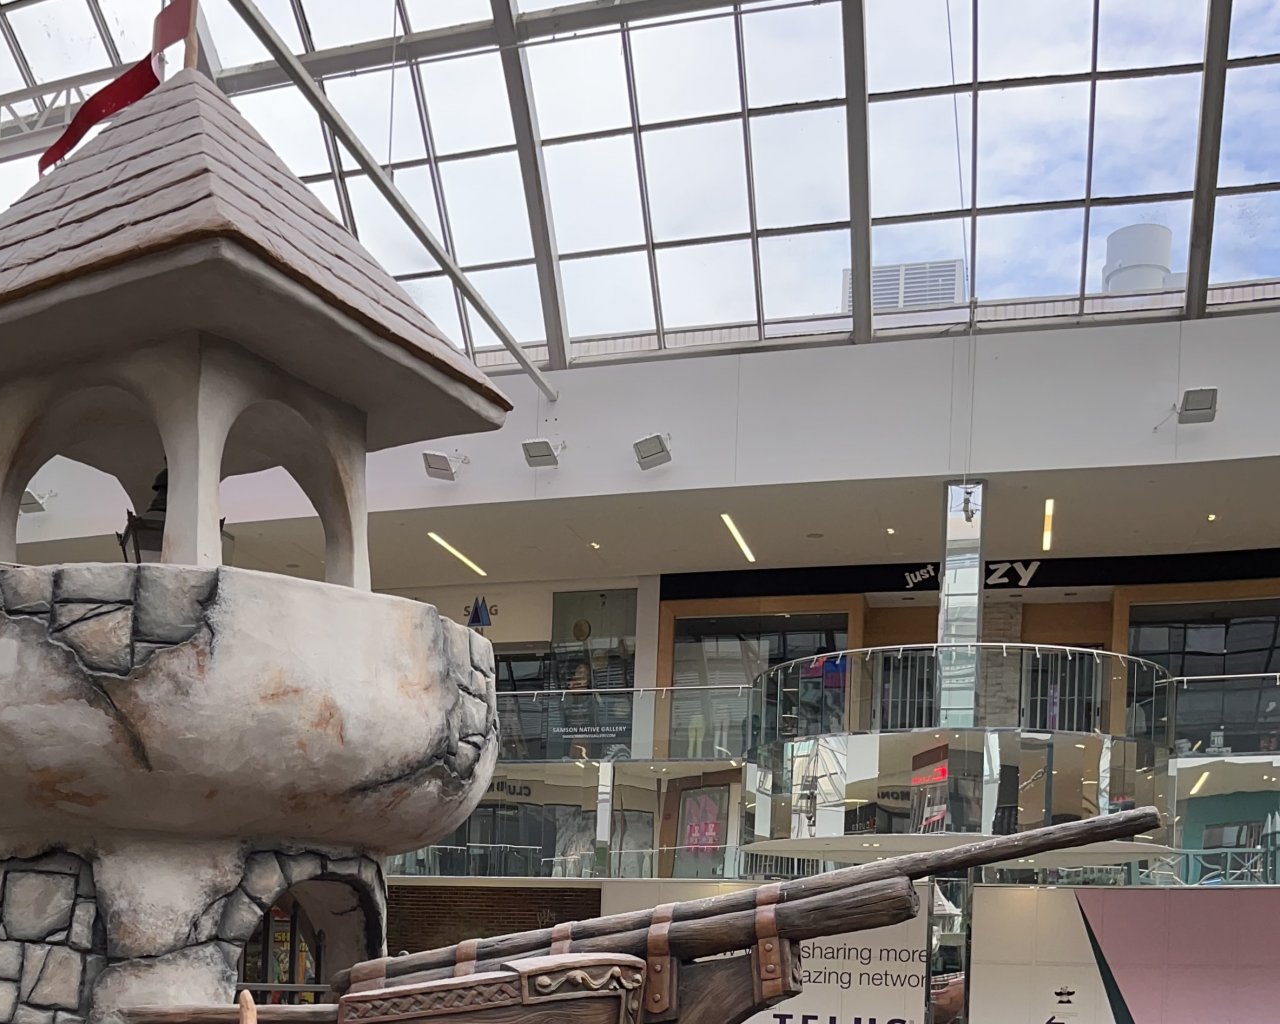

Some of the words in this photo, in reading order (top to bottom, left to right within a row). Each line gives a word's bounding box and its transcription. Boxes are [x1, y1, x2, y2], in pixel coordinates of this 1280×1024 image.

[904, 563, 936, 589] just
[801, 942, 872, 966] sharing
[879, 948, 928, 964] more
[803, 966, 853, 990] azing
[859, 970, 926, 989] networ
